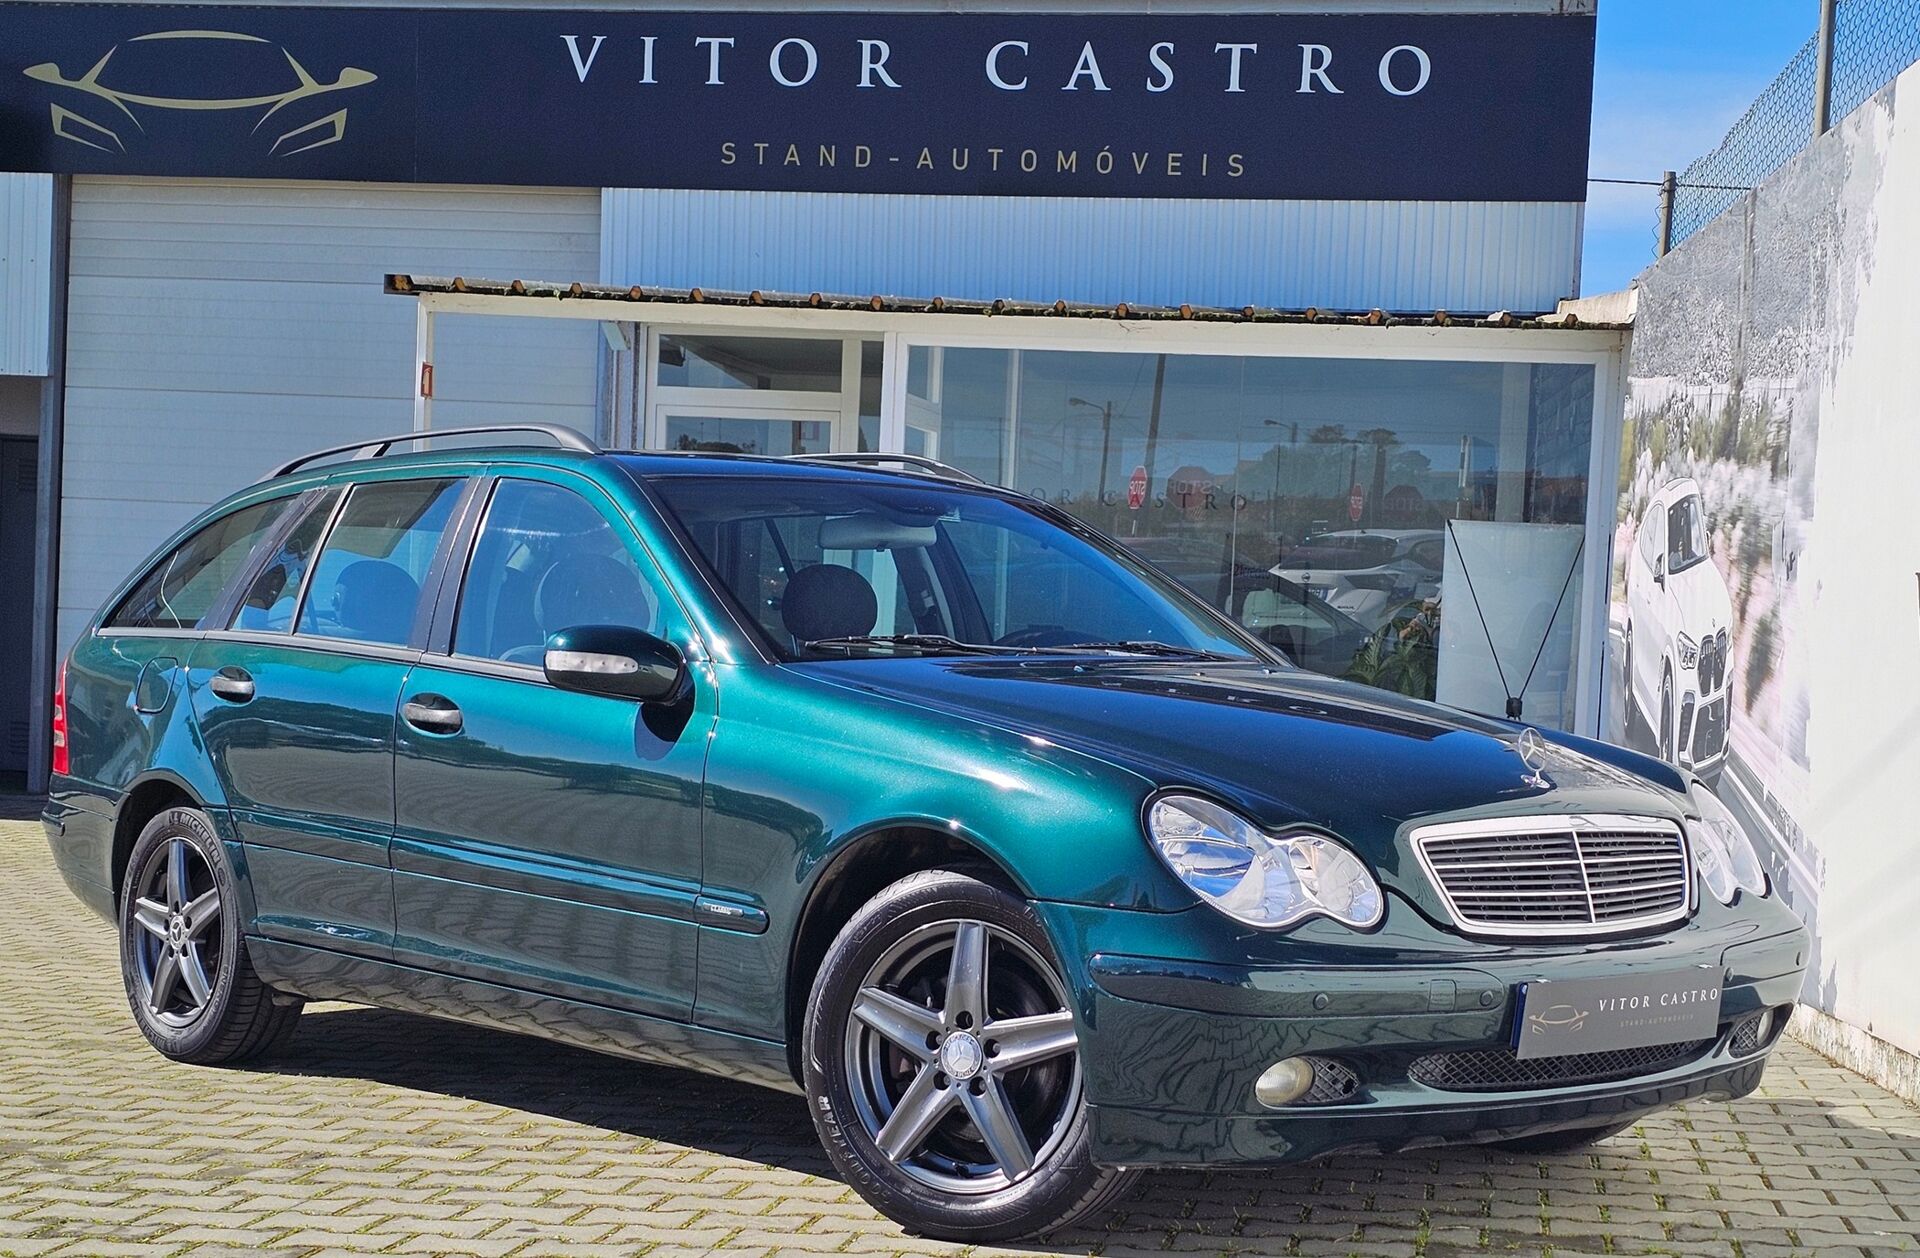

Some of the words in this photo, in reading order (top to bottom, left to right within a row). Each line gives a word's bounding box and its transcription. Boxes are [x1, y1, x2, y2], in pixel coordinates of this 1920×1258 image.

[560, 35, 902, 88] VITOR
[985, 40, 1431, 96] CASTRO
[721, 142, 1245, 177] STAND-AUTOMÓVEIS
[1102, 488, 1247, 511] CASTRO
[180, 812, 221, 867] MICHELIN
[1599, 995, 1650, 1012] VITOR
[1660, 988, 1718, 1006] CASTRO
